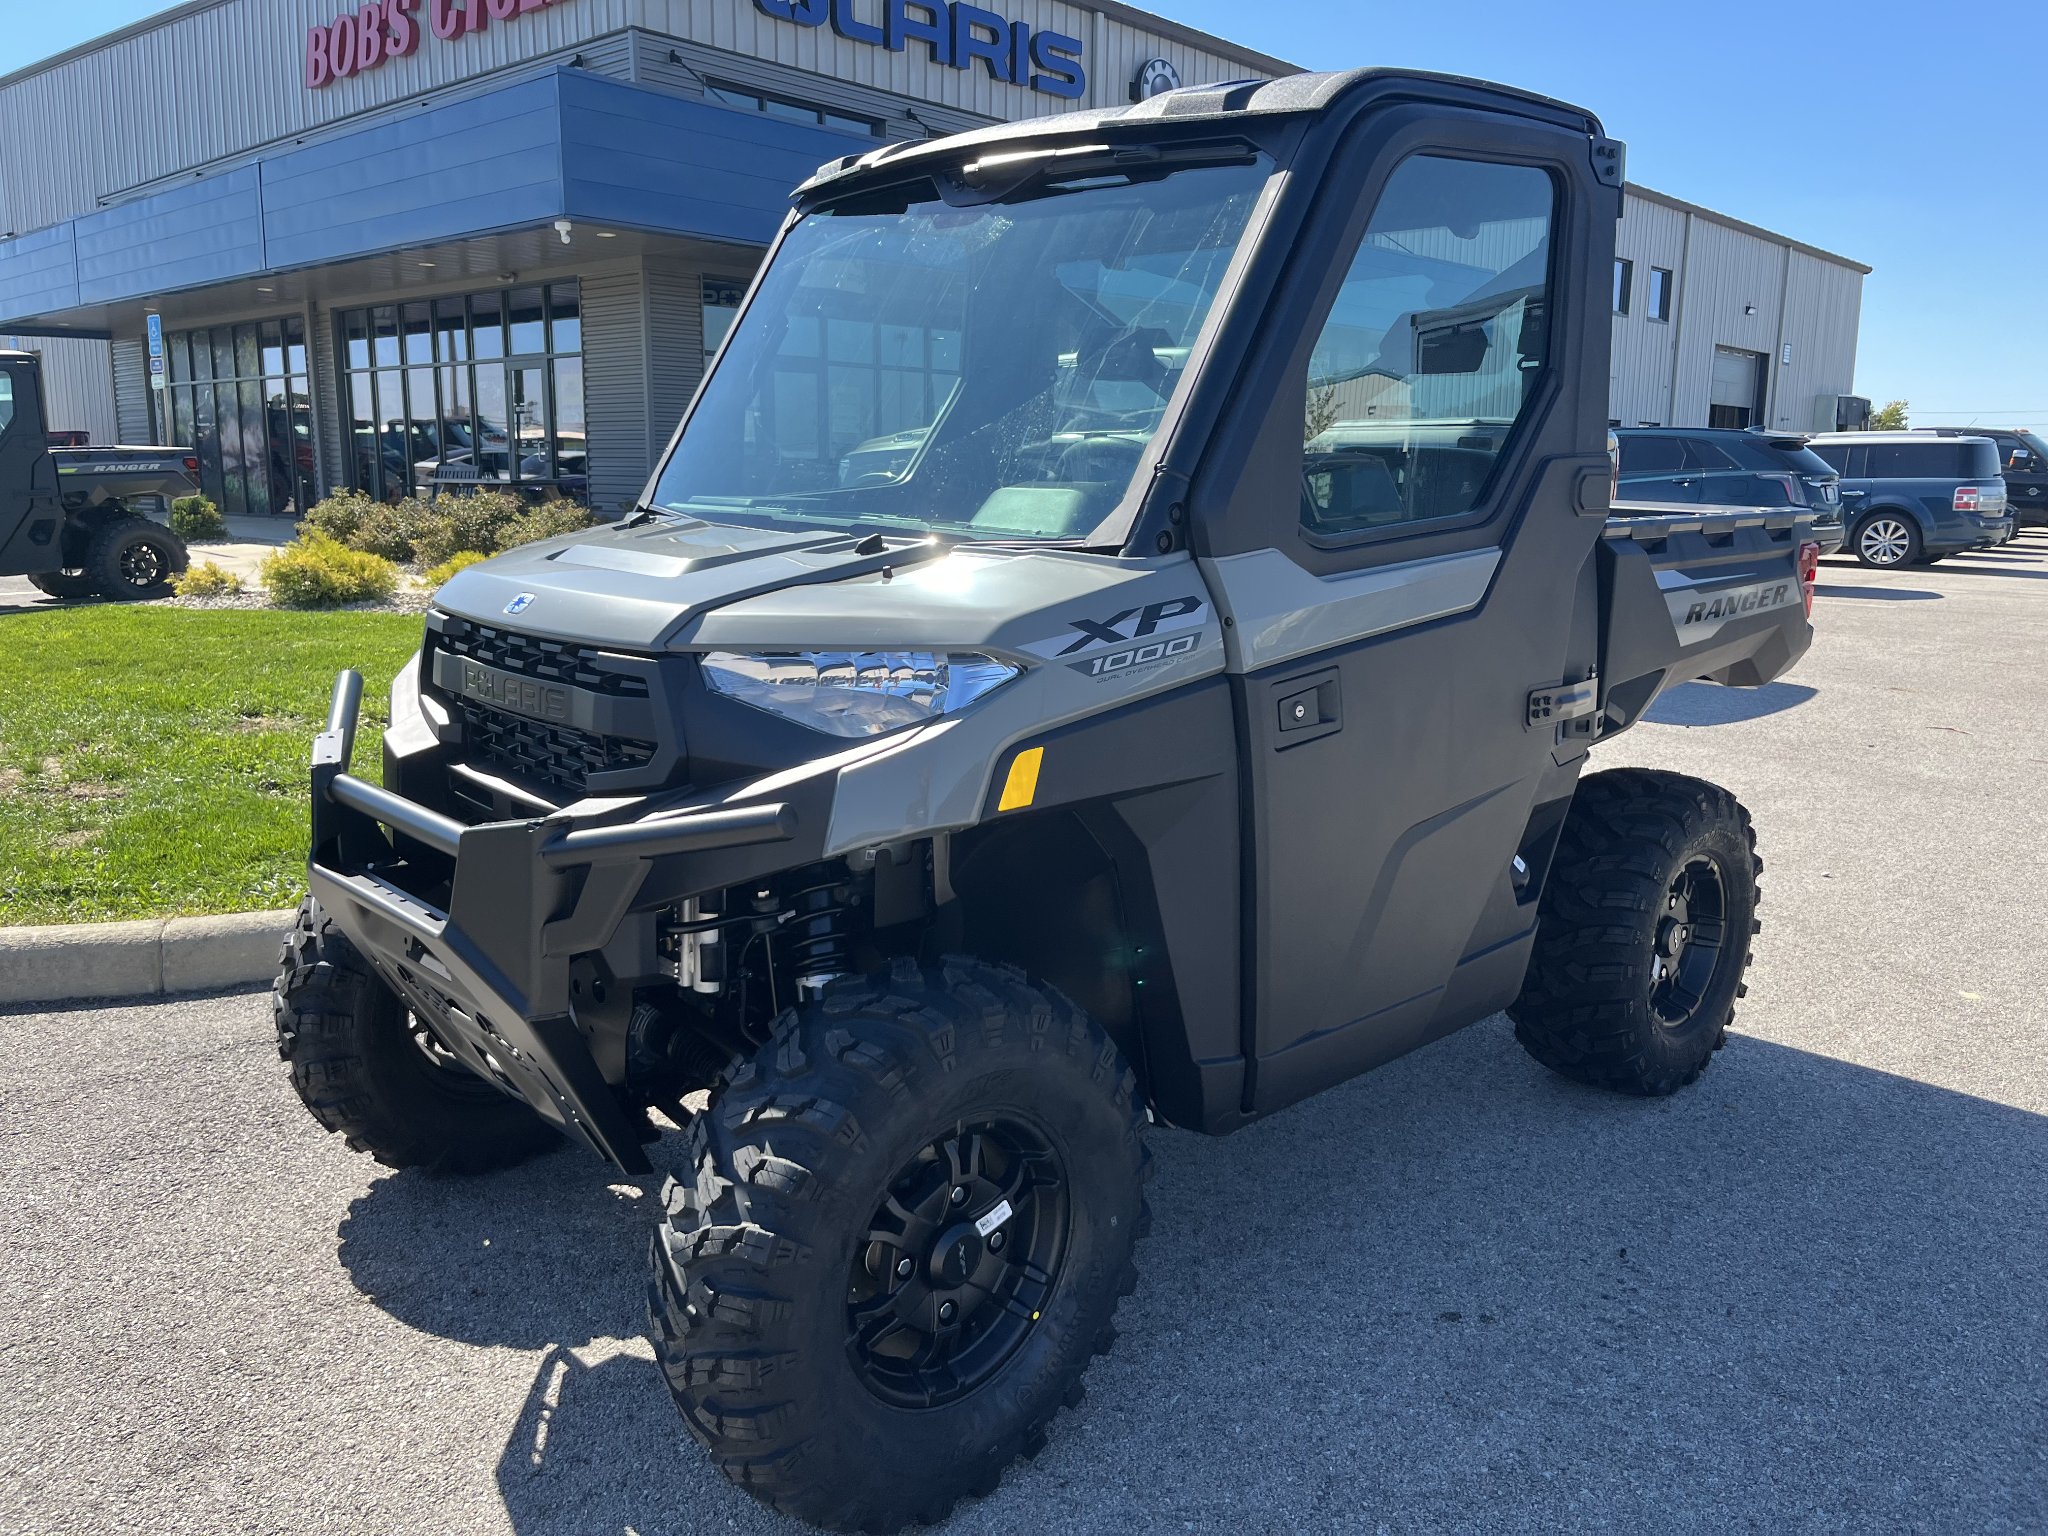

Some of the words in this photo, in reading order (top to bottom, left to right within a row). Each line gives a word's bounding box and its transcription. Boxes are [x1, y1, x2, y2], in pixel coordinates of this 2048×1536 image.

[305, 0, 420, 90] BOB'S
[93, 463, 161, 472] RANGER
[1055, 595, 1204, 657] XP
[1684, 584, 1789, 625] RANGER
[1091, 635, 1195, 675] 1000
[463, 664, 568, 719] POLARIS
